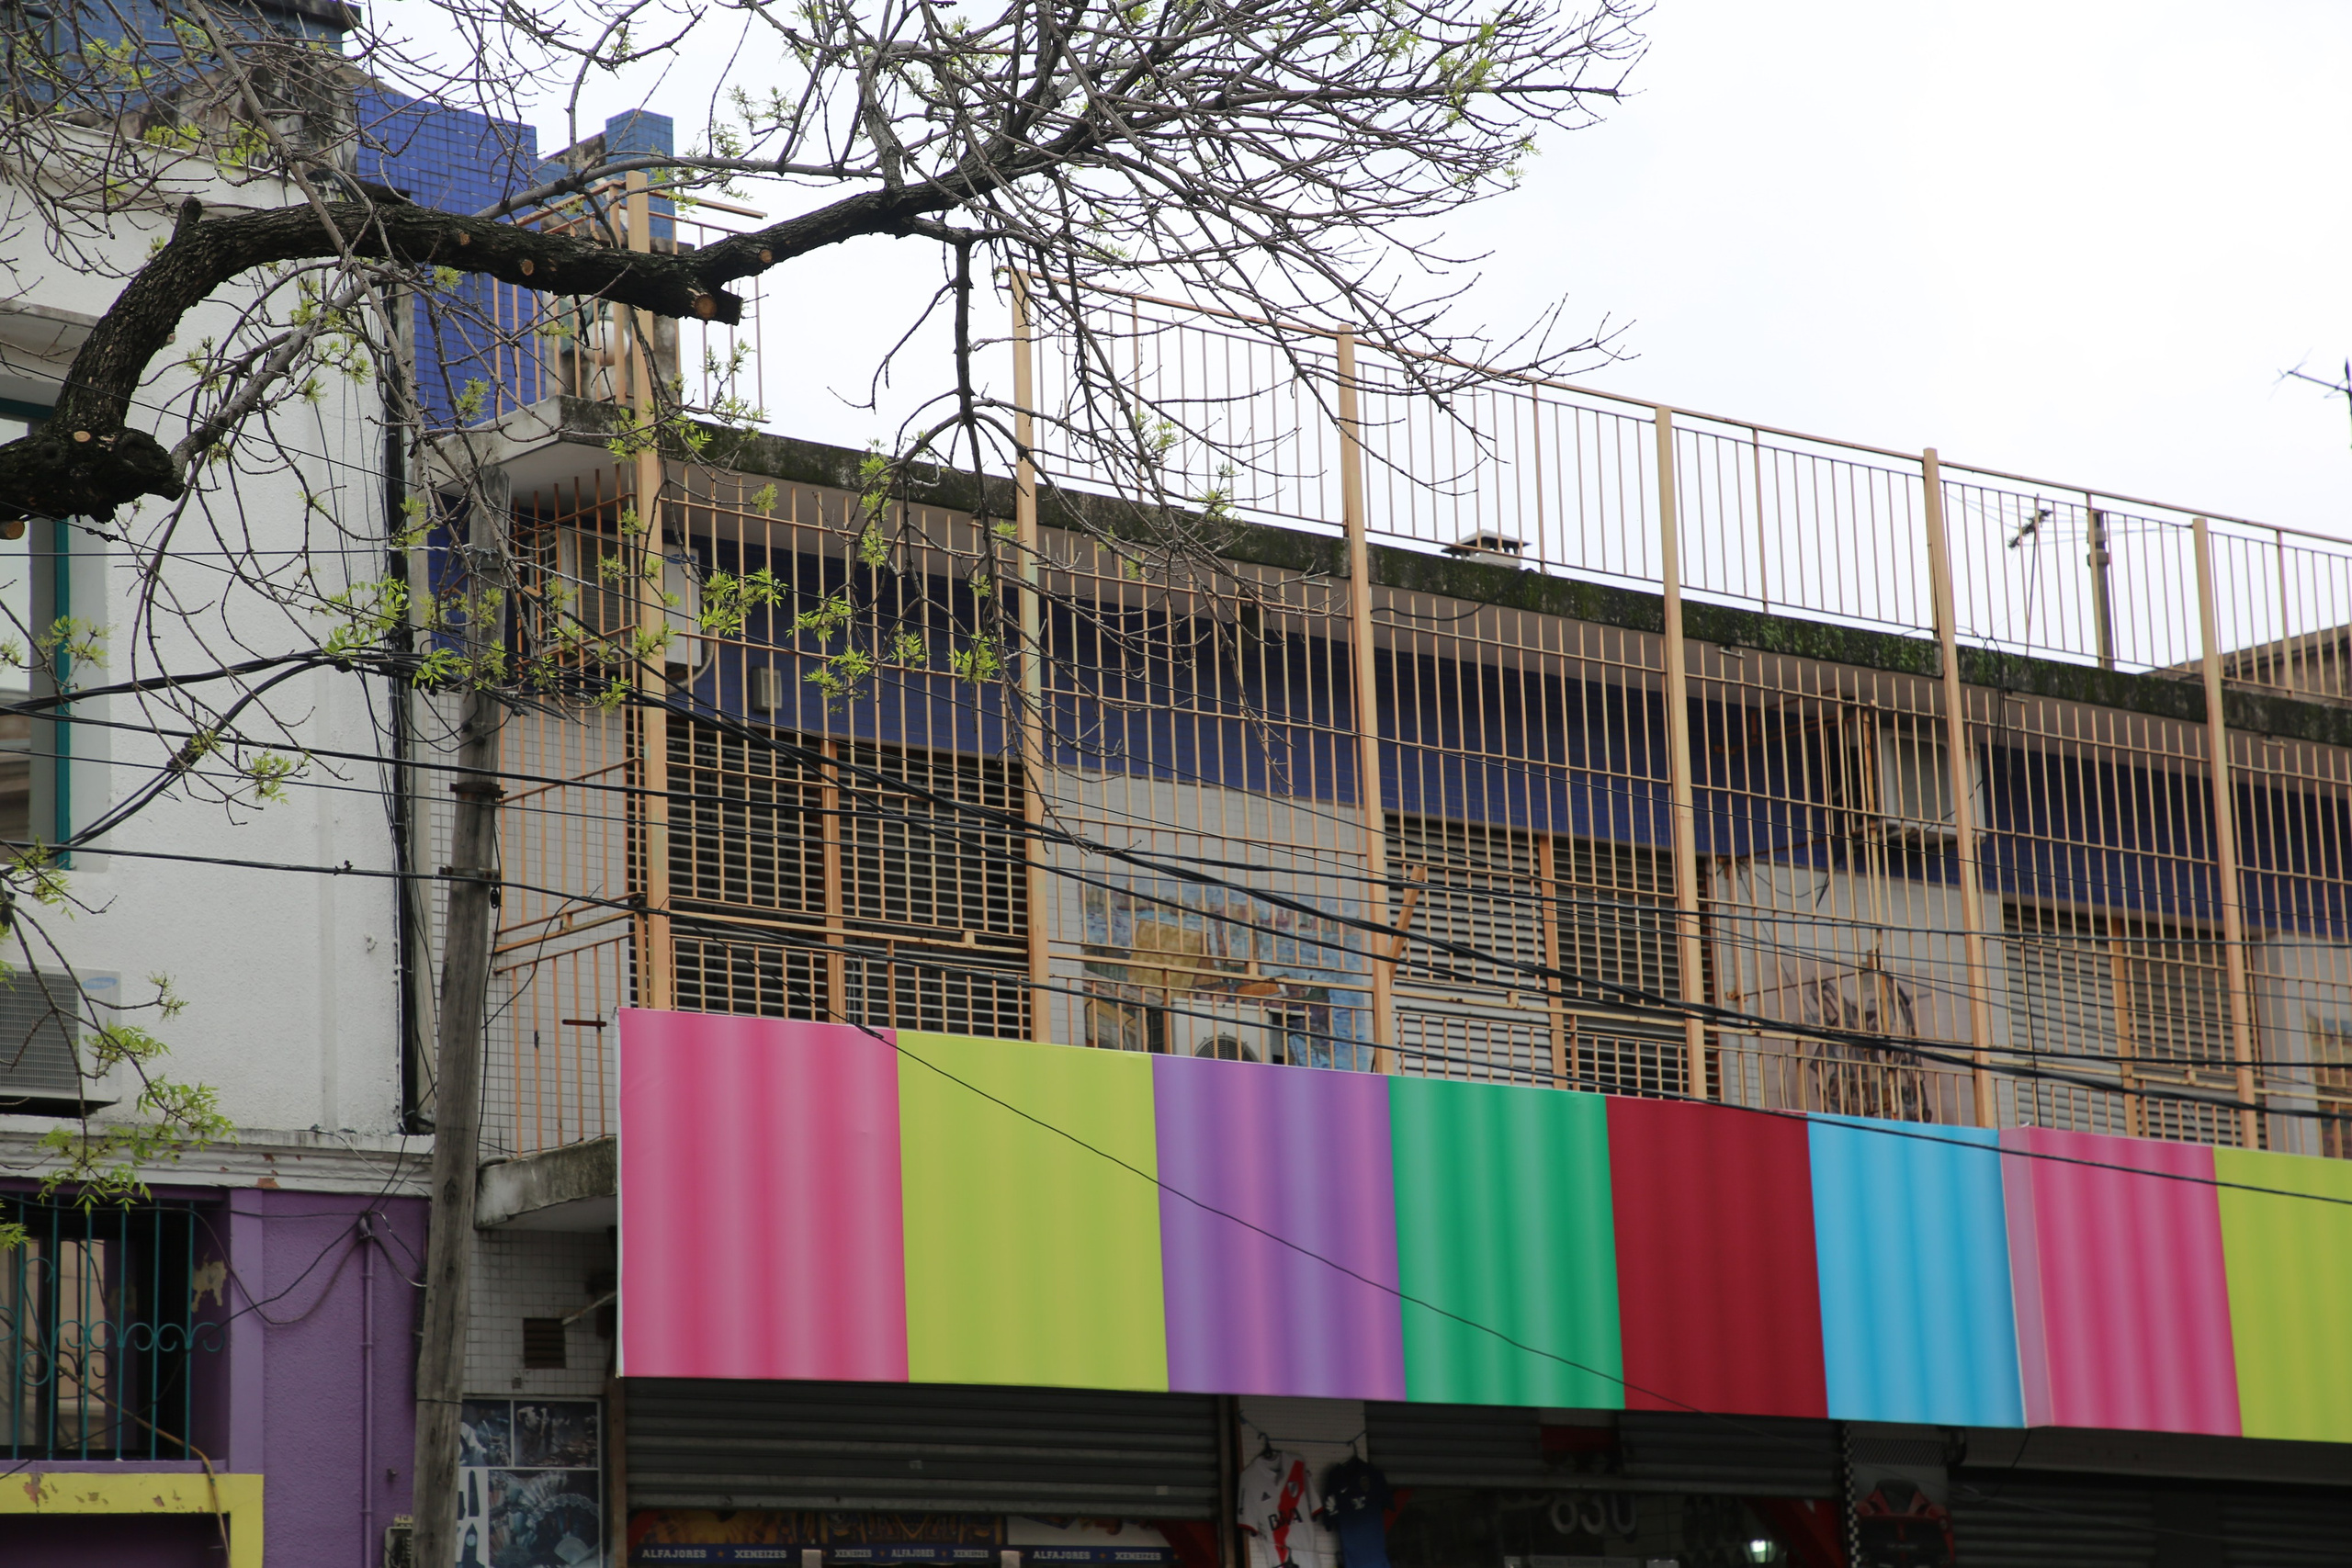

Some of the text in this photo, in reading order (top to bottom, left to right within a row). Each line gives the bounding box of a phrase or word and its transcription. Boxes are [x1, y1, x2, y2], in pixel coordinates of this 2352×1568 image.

[641, 1549, 787, 1559] ALFAJORES XENEIZES
[1033, 1551, 1161, 1561] ALFAJORES XENEIZES
